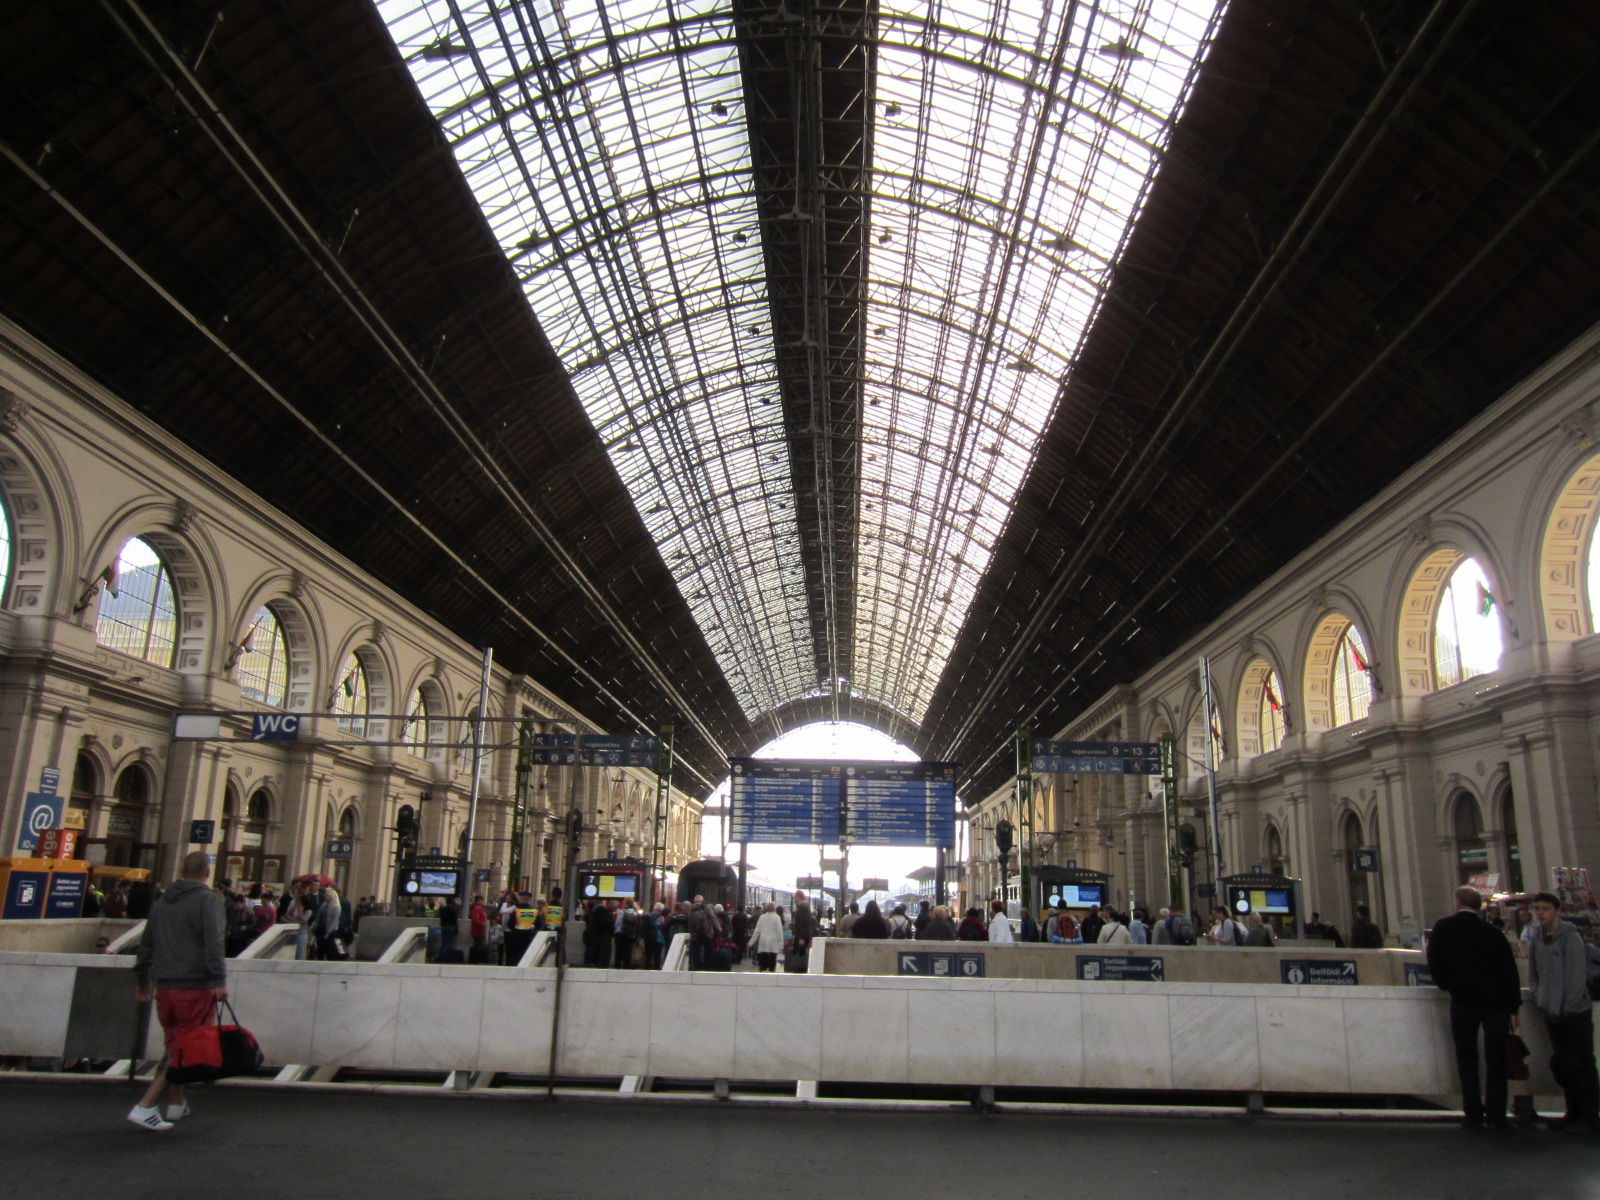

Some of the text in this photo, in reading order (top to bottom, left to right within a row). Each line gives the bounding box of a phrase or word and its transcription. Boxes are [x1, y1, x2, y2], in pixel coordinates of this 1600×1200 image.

[258, 715, 298, 733] WC
[1112, 746, 1119, 755] 9
[1131, 747, 1143, 756] 13
[410, 872, 417, 880] 6
[588, 875, 595, 884] 7
[1052, 885, 1058, 894] 8
[1238, 890, 1245, 899] 9
[1310, 967, 1341, 976] Belföldi
[1310, 976, 1354, 985] Információ
